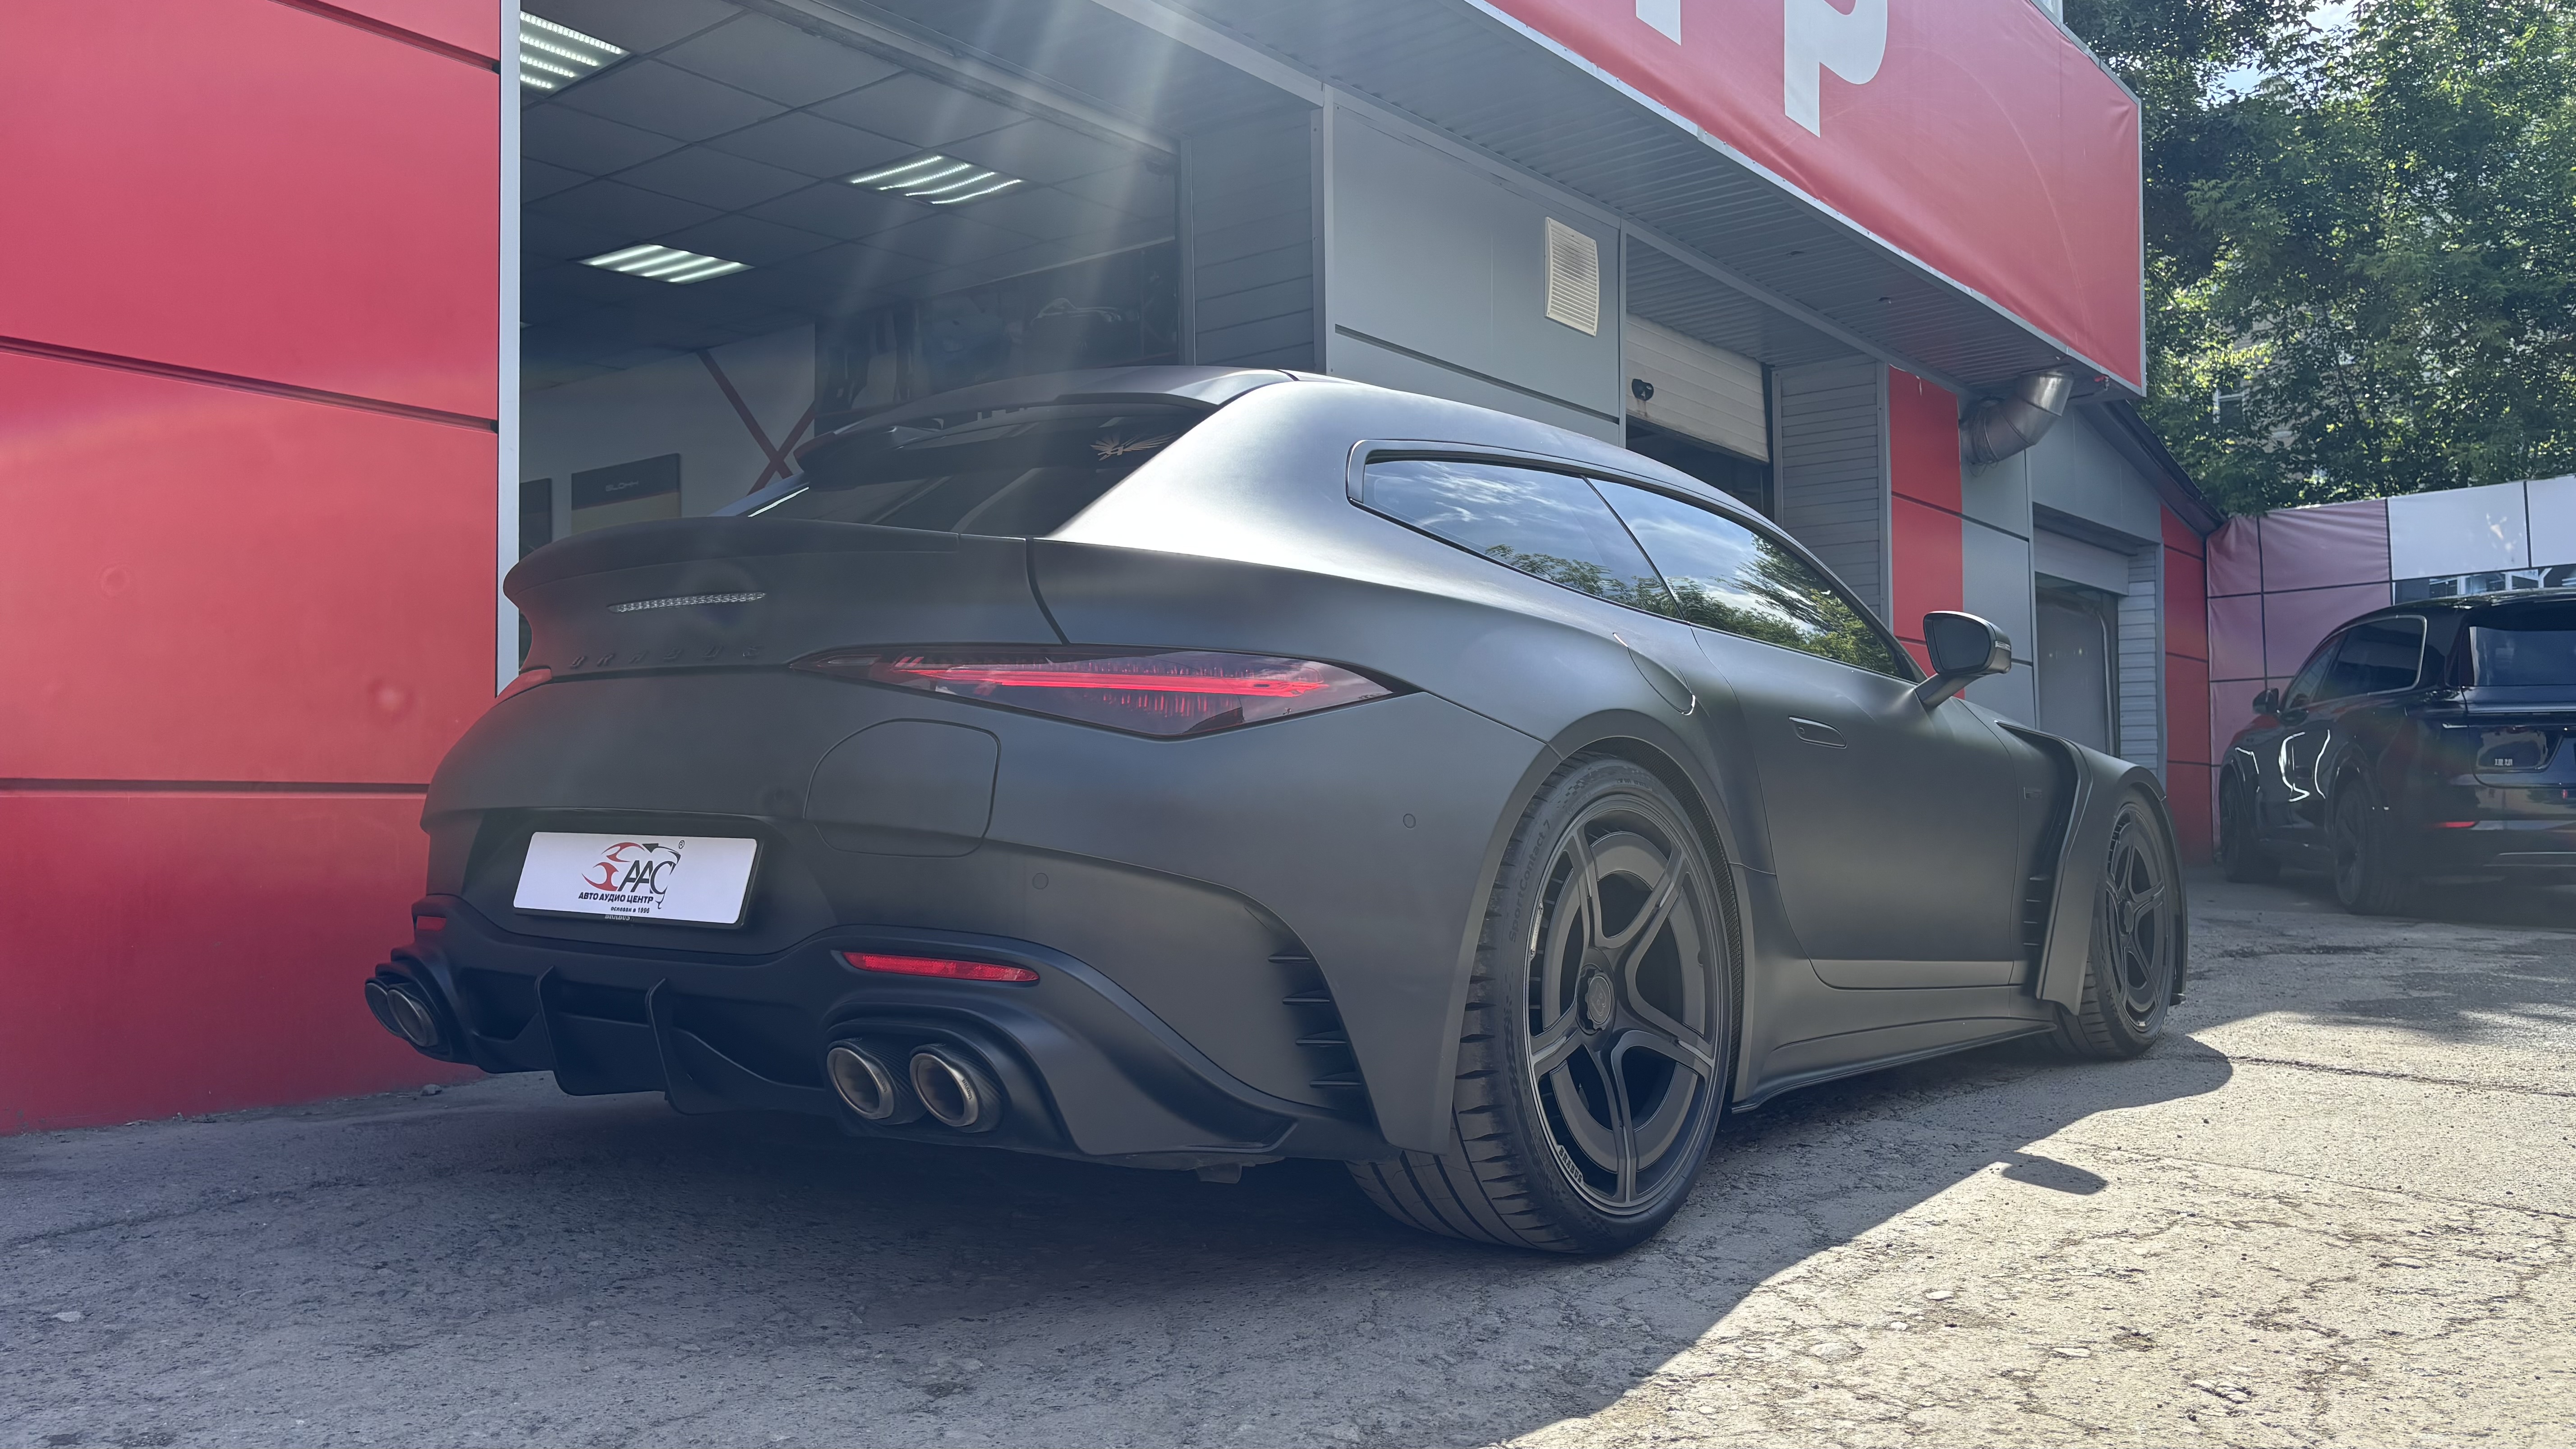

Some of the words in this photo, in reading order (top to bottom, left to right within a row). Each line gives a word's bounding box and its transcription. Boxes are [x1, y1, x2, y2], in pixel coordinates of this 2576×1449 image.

[578, 892, 599, 900] АВТО
[599, 893, 626, 903] АУДИО
[626, 895, 653, 904] ЦЕНТР
[1509, 831, 1546, 943] SportContact
[1543, 819, 1550, 829] 7
[1559, 1146, 1582, 1183] BRABUS
